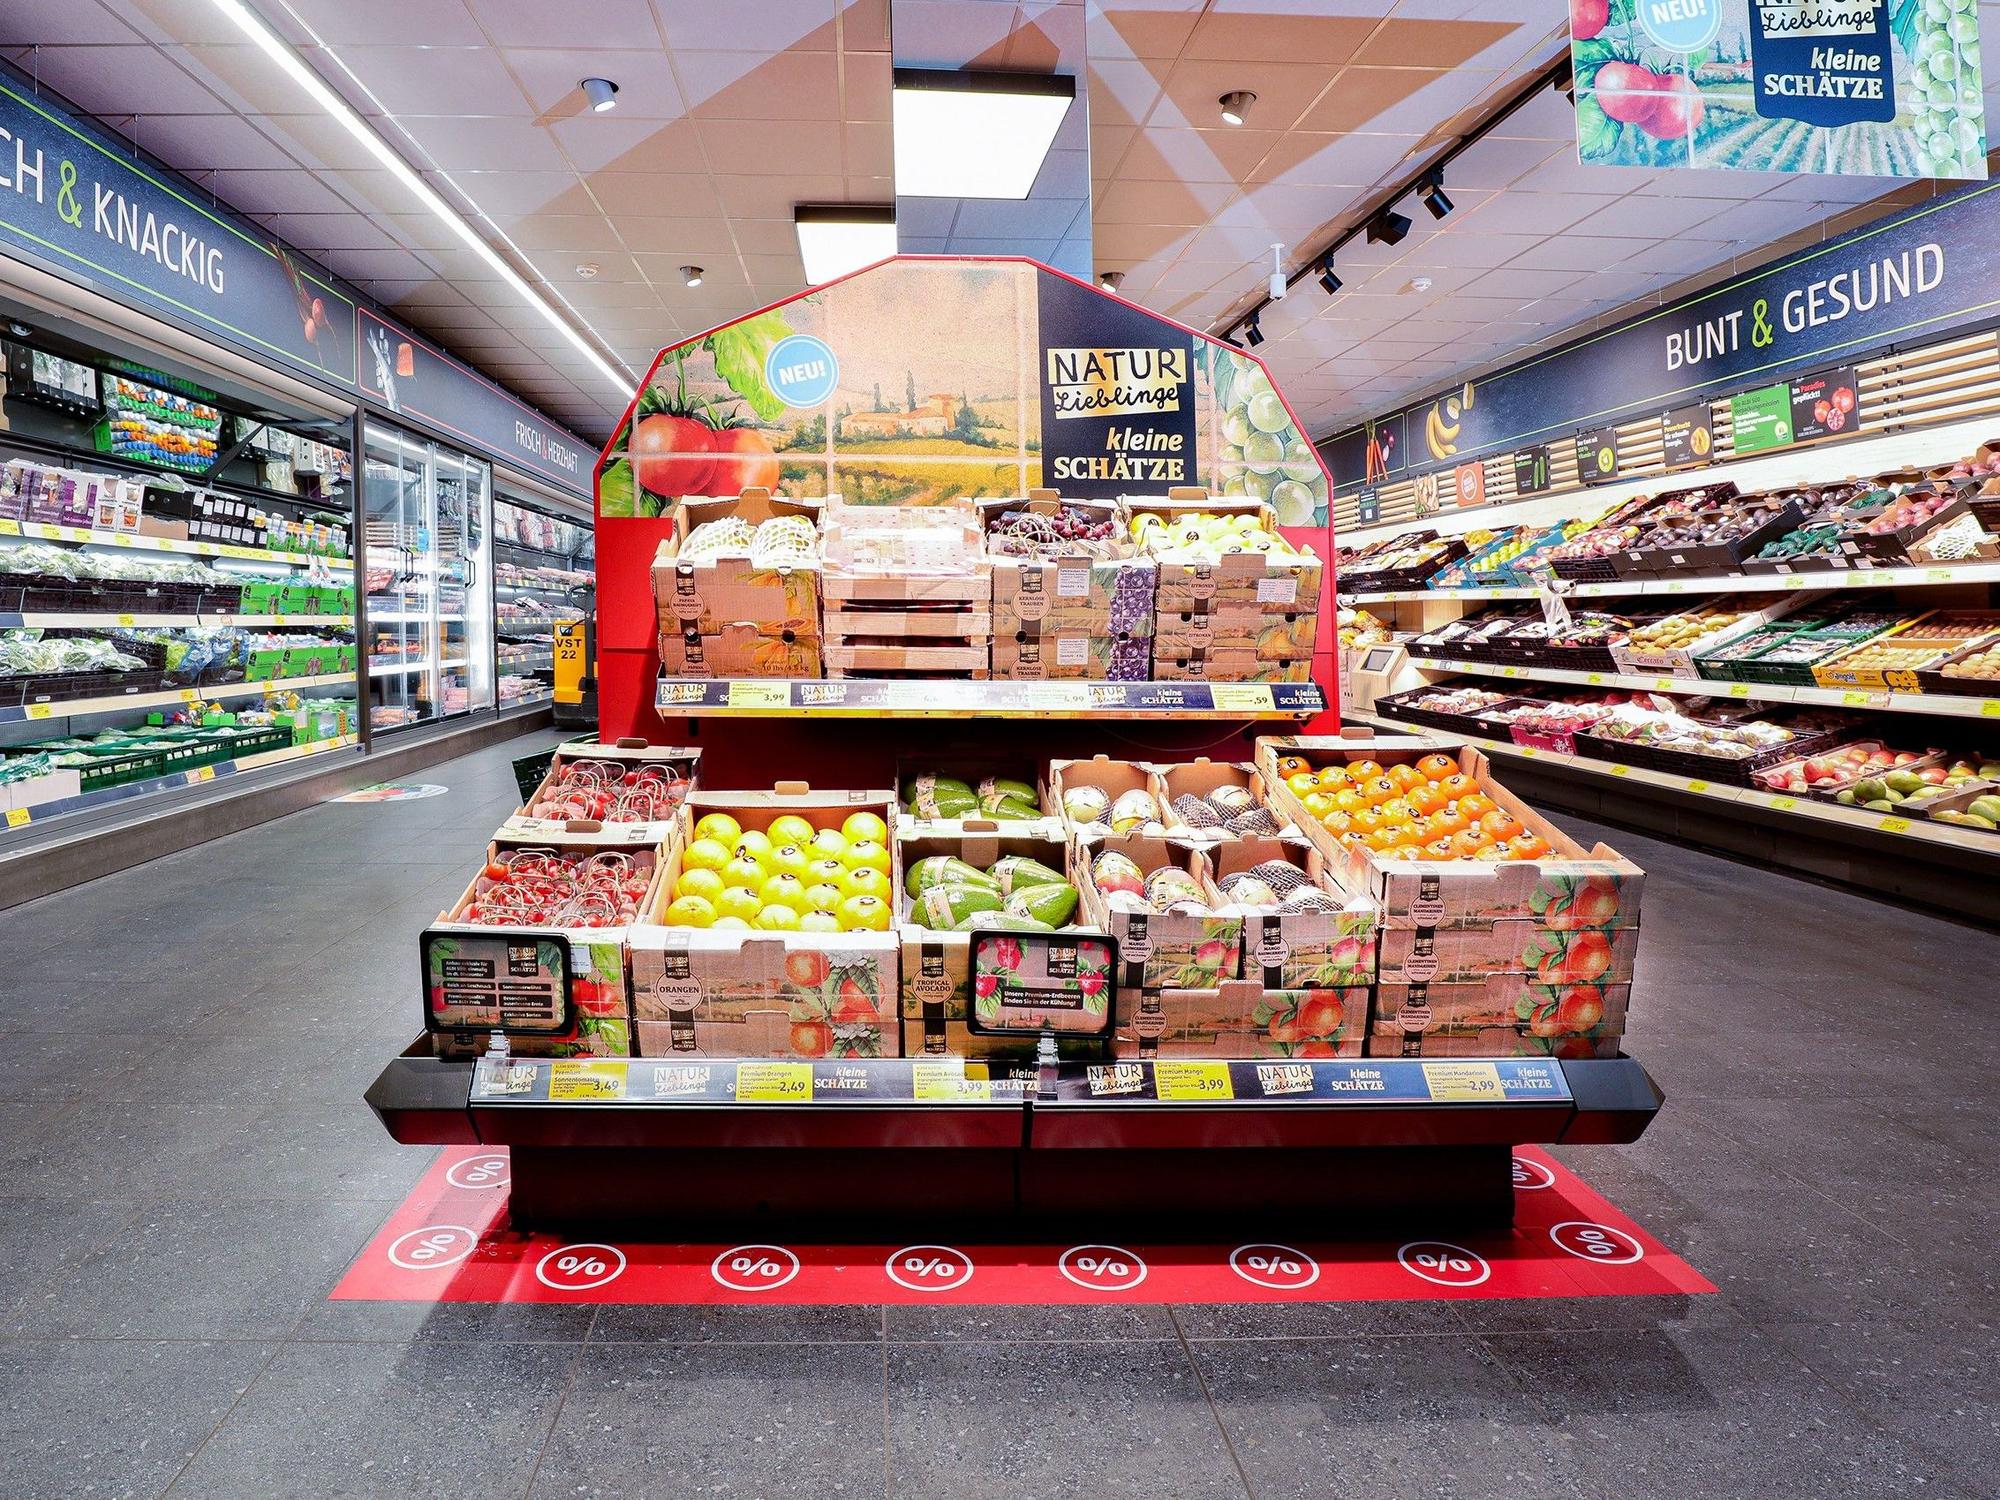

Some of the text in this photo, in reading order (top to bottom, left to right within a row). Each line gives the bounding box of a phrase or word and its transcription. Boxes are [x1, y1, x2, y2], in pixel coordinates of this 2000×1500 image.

[1763, 8, 1874, 32] Lieblinge
[1811, 47, 1881, 72] kleine
[1763, 71, 1885, 100] SCHÄTZE
[57, 160, 83, 229] &
[94, 181, 225, 294] KNACKIG
[1666, 243, 1946, 371] BUNT & GESUND
[778, 360, 827, 385] NEU!
[1055, 348, 1182, 386] NATUR
[1054, 385, 1180, 412] Lieblinge
[1106, 426, 1183, 451] kleine
[515, 420, 541, 456] FRISCH
[547, 439, 579, 475] HERZHAFT
[1053, 452, 1185, 481] SCHÄTZE
[555, 638, 583, 649] VST
[560, 649, 577, 660] 22
[662, 684, 706, 695] NATUR
[763, 693, 785, 702] 3,99
[1140, 694, 1185, 705] SCHÄTZE
[1279, 694, 1323, 705] SCHÄTZE
[659, 986, 700, 994] ORANGEN
[1004, 990, 1081, 1000] Unsere Premium-Erdbeeren
[656, 1067, 709, 1081] NATUR
[835, 1067, 868, 1077] kleine
[1089, 1065, 1143, 1080] NATUR
[1259, 1065, 1312, 1080] NATUR
[1350, 1068, 1381, 1079] kleine
[1517, 1067, 1549, 1078] kleine
[592, 1079, 619, 1093] 3,49
[779, 1081, 806, 1094] 2,49
[814, 1076, 868, 1089] SCHÄTZE
[957, 1081, 983, 1094] 3,99
[1090, 1080, 1142, 1095] Lieblinge
[1198, 1079, 1224, 1092] 3,99
[1263, 1080, 1313, 1093] Lieblinge
[1331, 1077, 1385, 1091] SCHÄTZE
[1469, 1080, 1495, 1092] 2,99
[1501, 1076, 1553, 1090] SCHÄTZE
